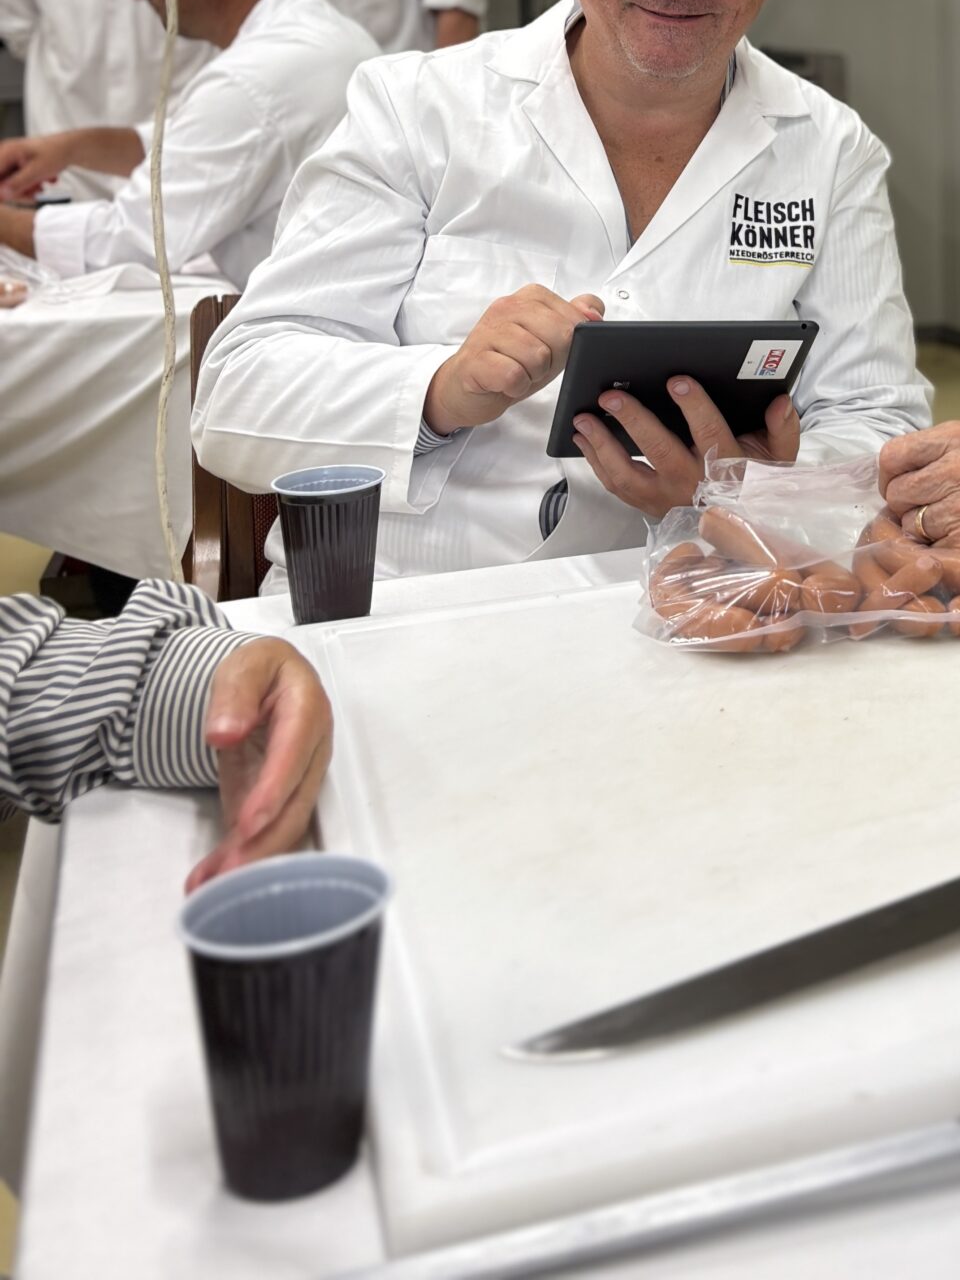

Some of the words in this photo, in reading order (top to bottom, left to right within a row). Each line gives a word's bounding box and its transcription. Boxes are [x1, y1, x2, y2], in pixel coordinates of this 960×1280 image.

[732, 193, 815, 224] FLEISCH
[730, 222, 815, 250] KÖNNER
[729, 249, 815, 262] NIEDERÖSTERREICH
